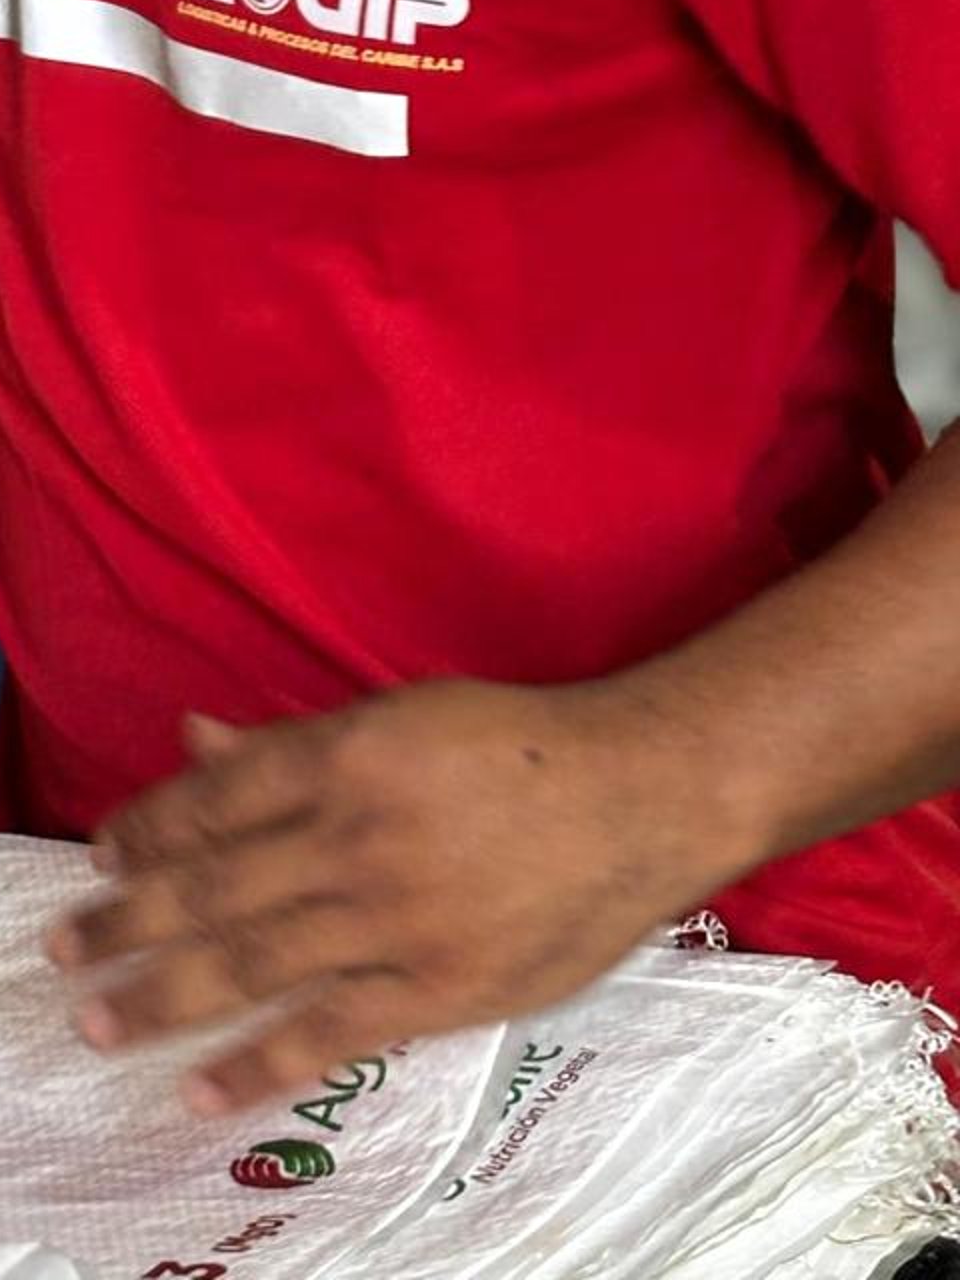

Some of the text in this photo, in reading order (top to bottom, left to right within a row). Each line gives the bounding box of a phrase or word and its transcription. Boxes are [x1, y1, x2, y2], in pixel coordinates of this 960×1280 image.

[247, 22, 258, 35] &
[259, 25, 329, 54] PROCESOS
[330, 43, 359, 61] DEL
[361, 49, 421, 69] CARIBE
[534, 1047, 599, 1104] Vegetal
